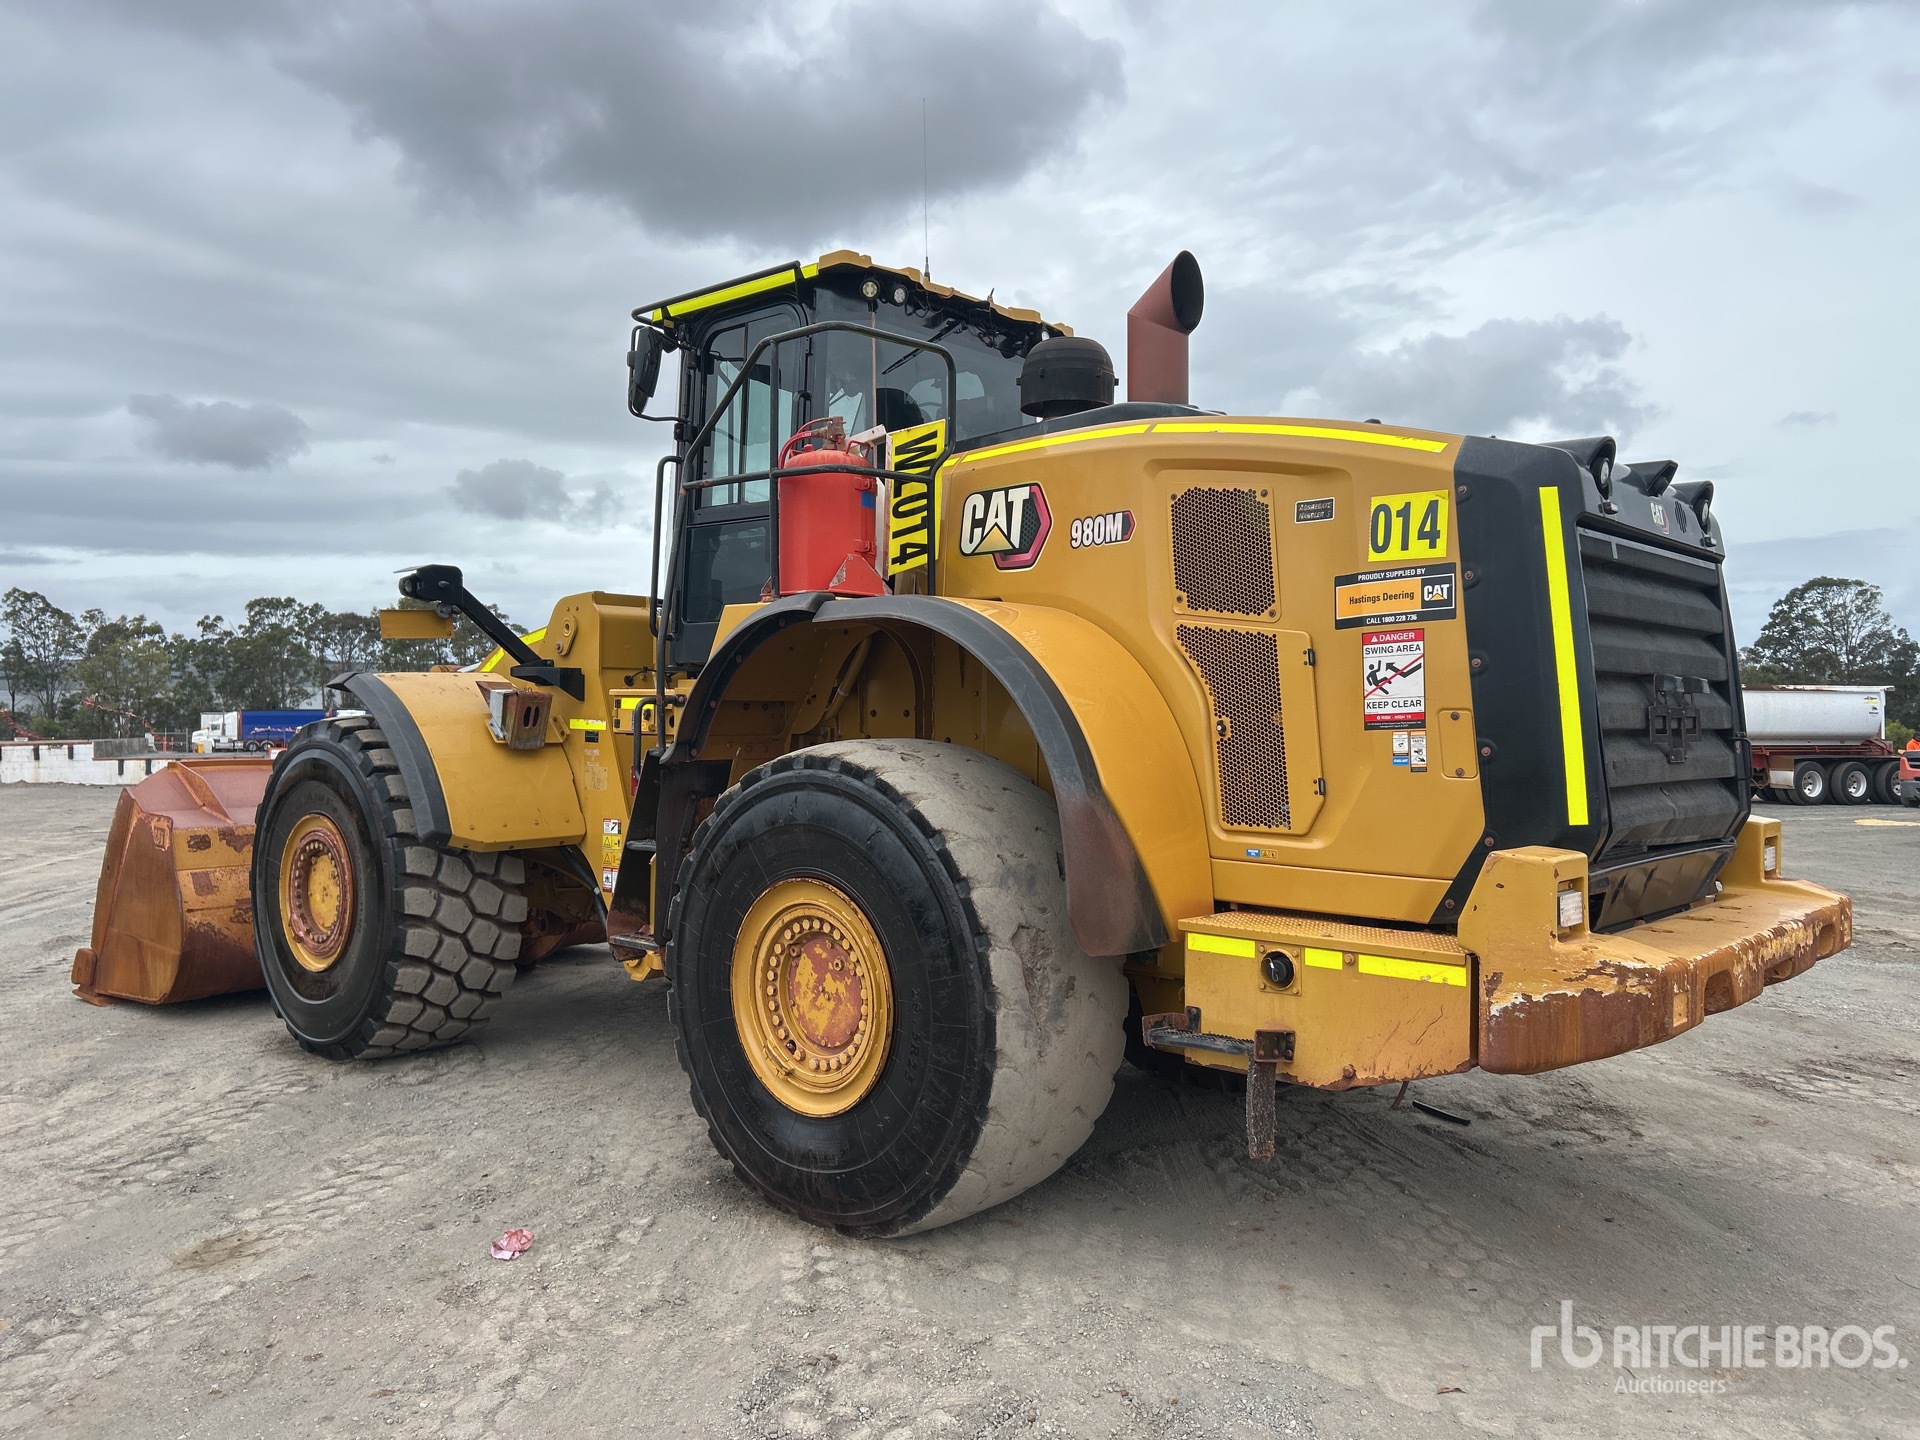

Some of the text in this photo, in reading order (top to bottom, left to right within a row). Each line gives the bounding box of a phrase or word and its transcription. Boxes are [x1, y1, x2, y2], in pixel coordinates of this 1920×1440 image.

[960, 486, 1030, 554] CAT
[1650, 502, 1665, 526] CAT
[1072, 512, 1123, 547] 980M
[1370, 499, 1441, 554] 014
[1357, 567, 1426, 582] PROUDLY SUPPLIED BY
[1349, 590, 1415, 605] Hastings Deering
[1423, 584, 1450, 601] CAT
[1366, 616, 1381, 625] CALL
[1379, 632, 1415, 642] DANGER
[1365, 644, 1421, 655] SWING AREA
[1366, 699, 1422, 710] KEEP CLEAR
